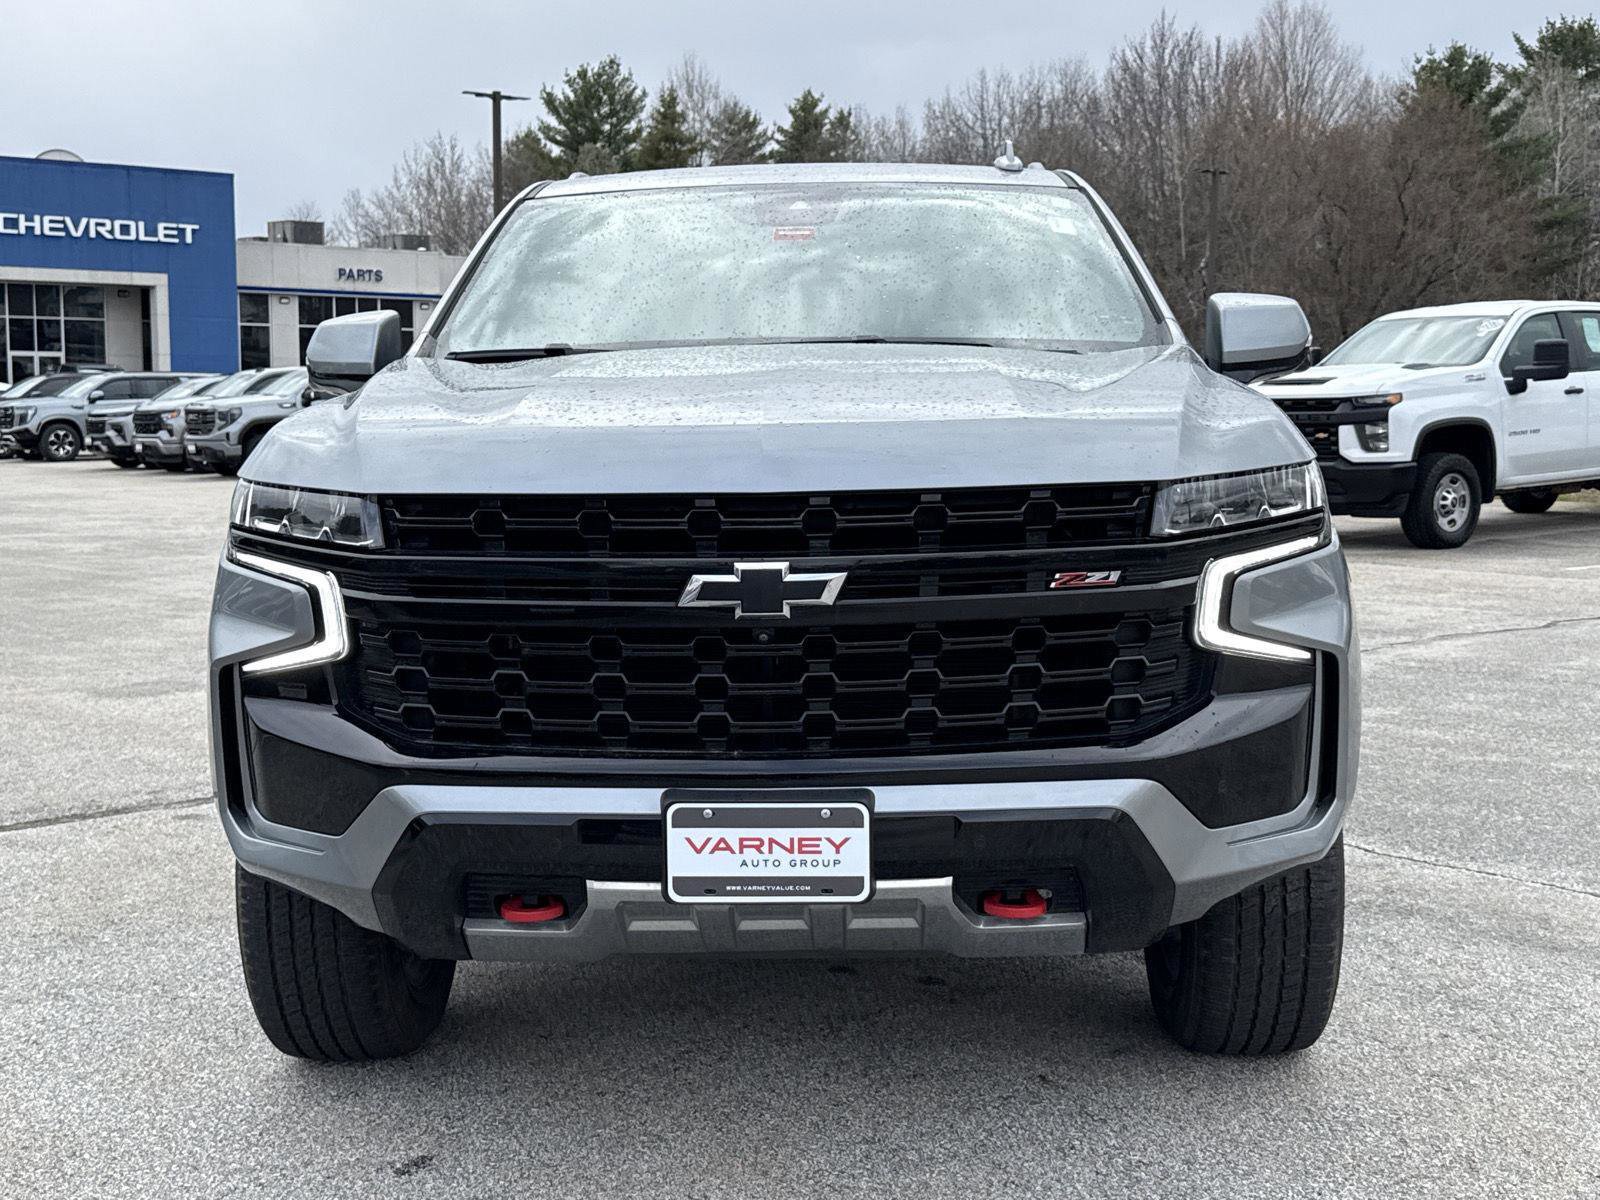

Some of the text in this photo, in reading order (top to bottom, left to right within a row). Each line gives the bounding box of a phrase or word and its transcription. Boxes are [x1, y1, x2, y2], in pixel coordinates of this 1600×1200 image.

[0, 212, 200, 244] CHEVROLET
[338, 267, 383, 282] PARTS
[1049, 570, 1122, 588] Z71
[684, 836, 851, 855] VARNEY
[739, 859, 842, 868] AUTO GROUP
